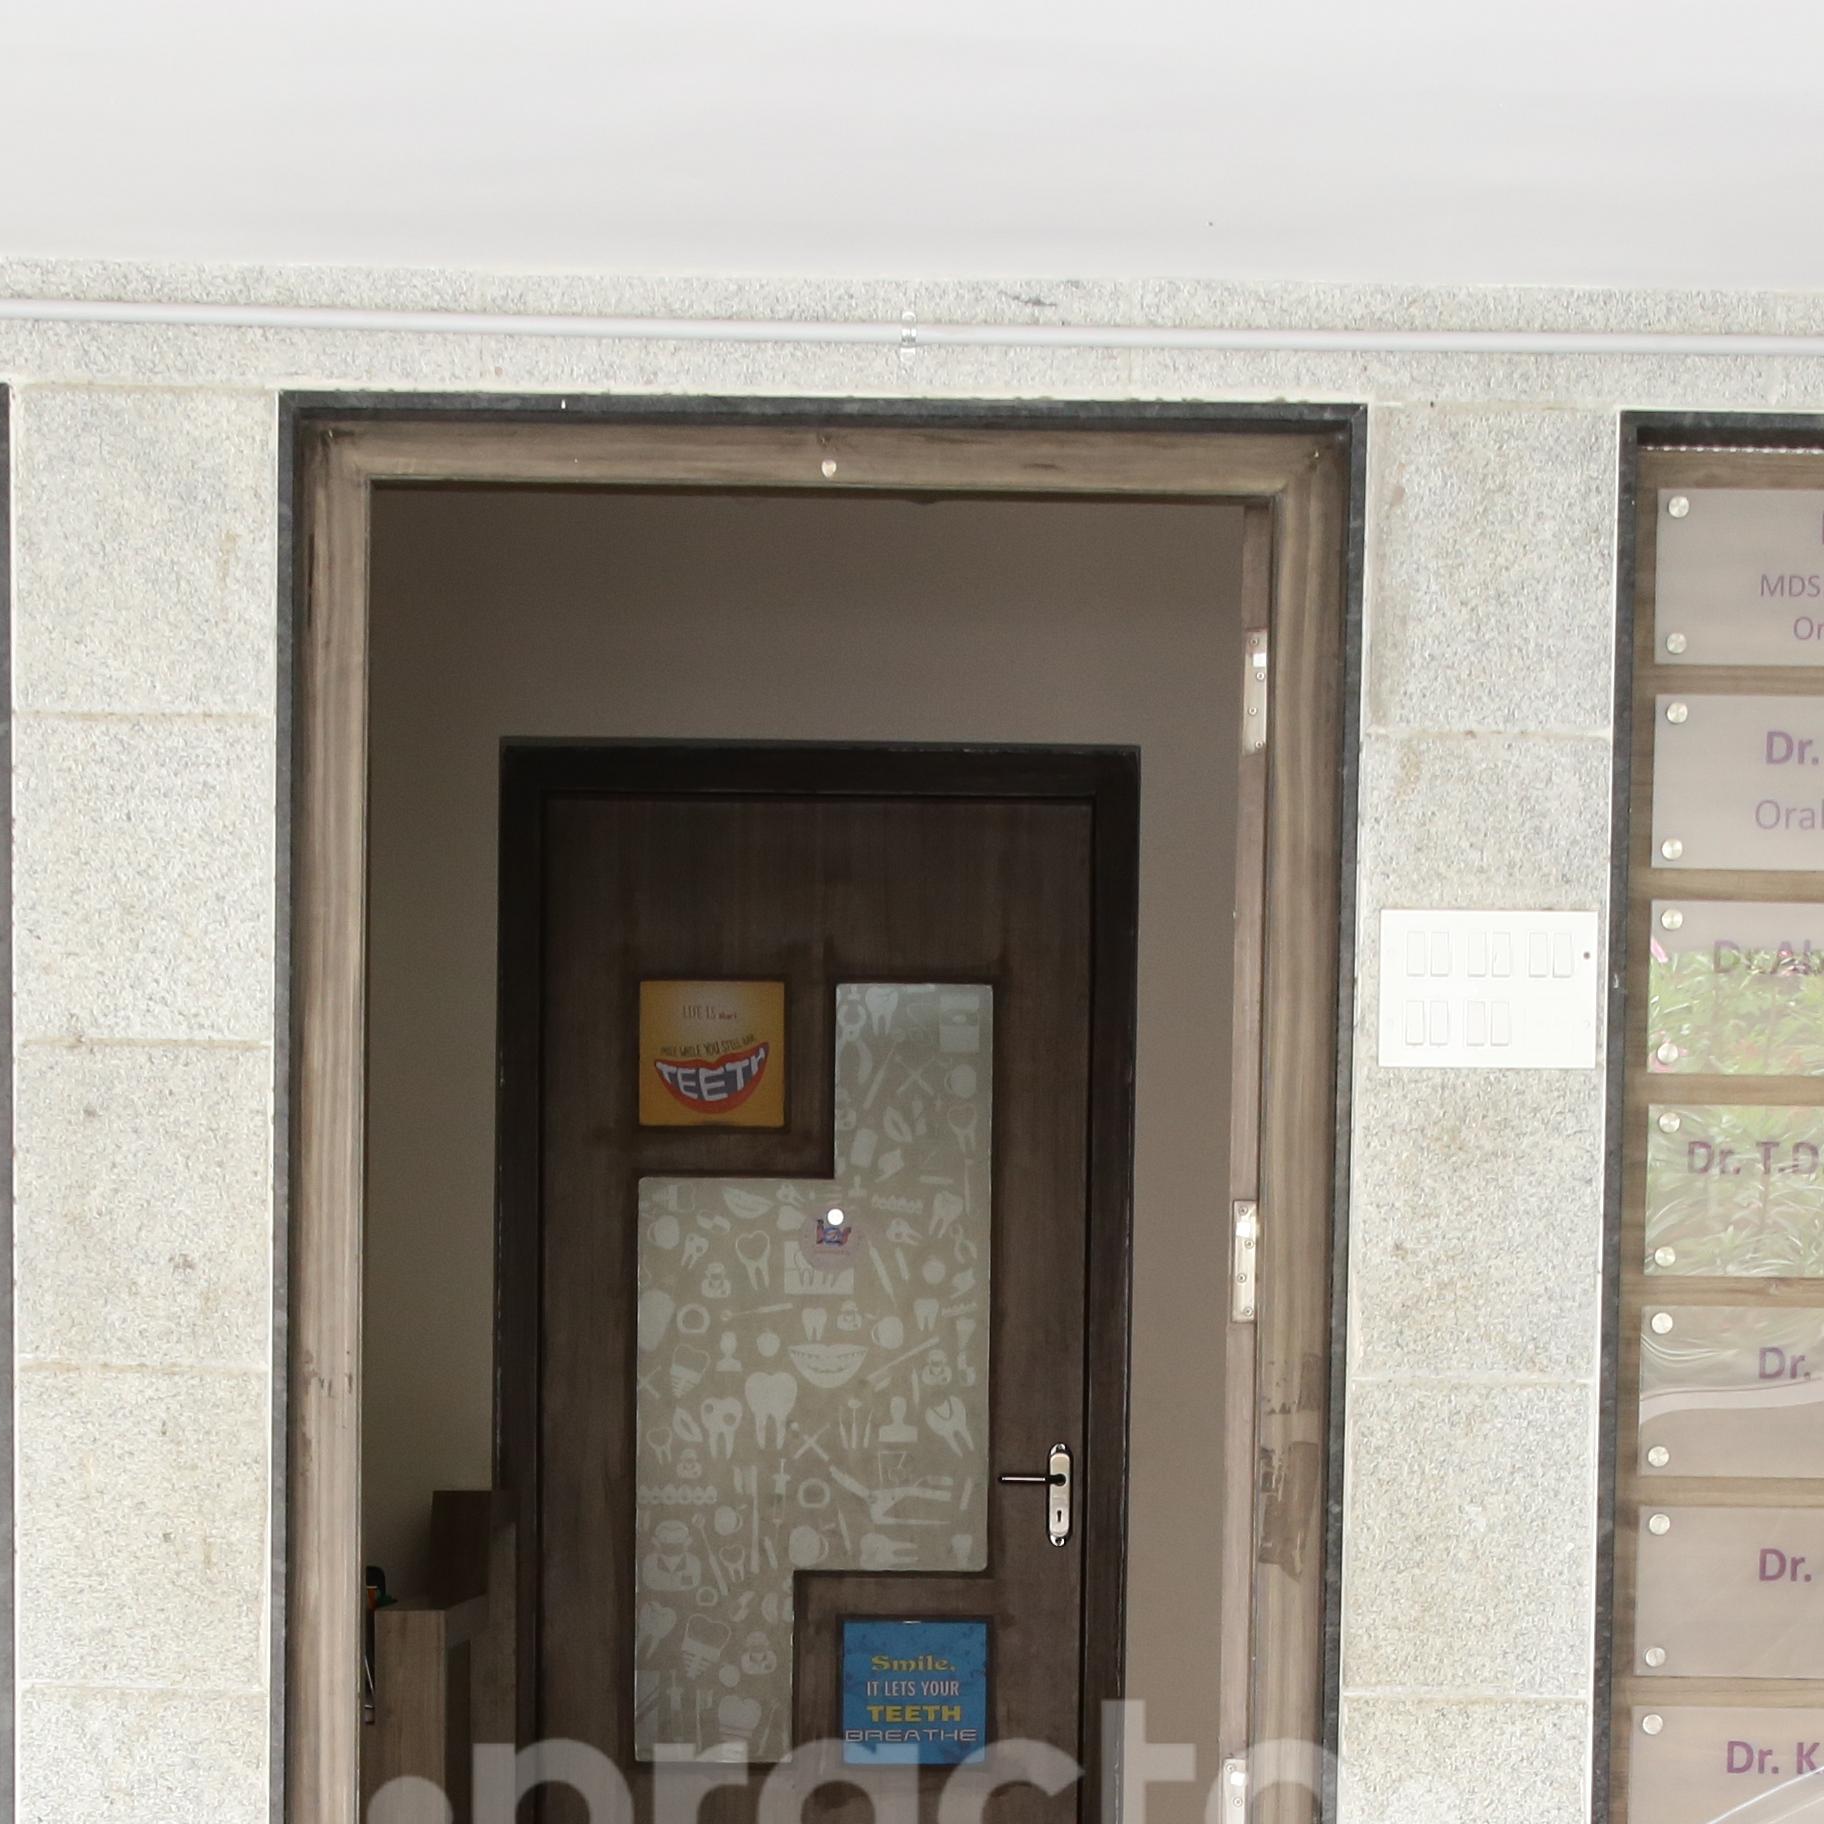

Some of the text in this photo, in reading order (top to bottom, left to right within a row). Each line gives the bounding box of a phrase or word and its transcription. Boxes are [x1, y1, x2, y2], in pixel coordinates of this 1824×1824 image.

[1765, 731, 1819, 766] Dr.
[656, 1047, 766, 1101] TEETH
[1686, 1140, 1741, 1175] Dr.
[1758, 1347, 1811, 1381] Dr.
[1758, 1549, 1812, 1582] Dr.
[866, 1680, 959, 1697] IT LETS YOUR
[866, 1705, 961, 1722] TEETH
[845, 1729, 977, 1742] BREATHE
[1726, 1741, 1779, 1774] Dr.
